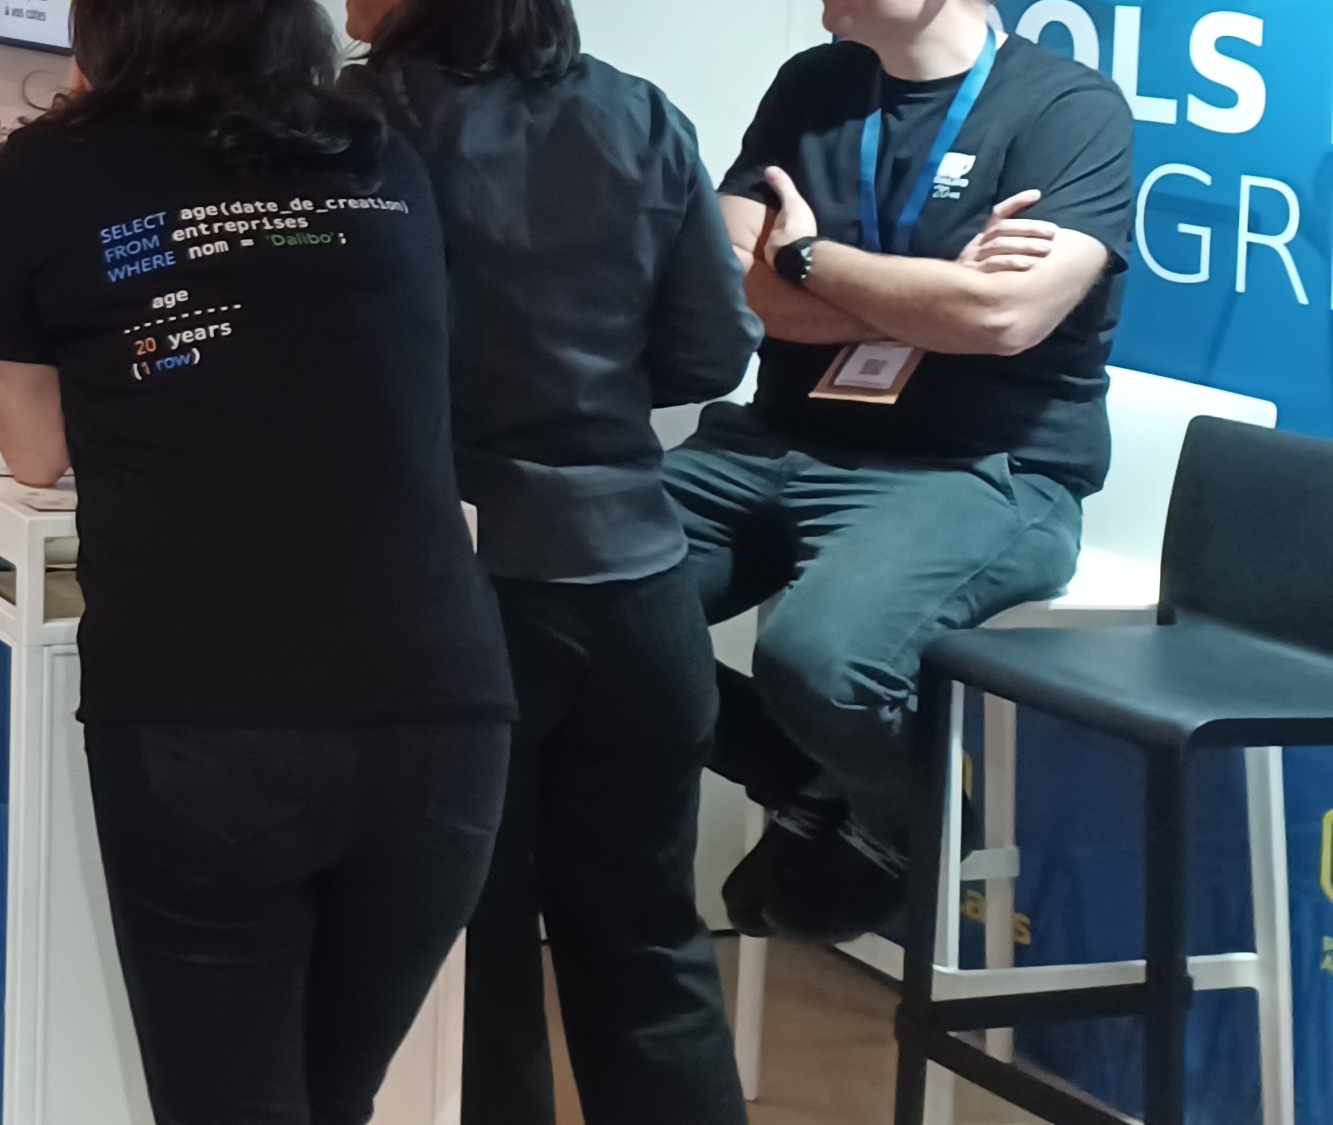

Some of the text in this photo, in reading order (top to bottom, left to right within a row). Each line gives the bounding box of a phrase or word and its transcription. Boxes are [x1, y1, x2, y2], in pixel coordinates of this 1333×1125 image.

[100, 211, 168, 244] SELECT
[104, 215, 309, 263] FROM entreprises
[107, 250, 177, 282] WHERE
[188, 240, 229, 260] nom
[152, 289, 189, 310] age
[134, 320, 233, 356] 20 years
[155, 348, 200, 372] row)
